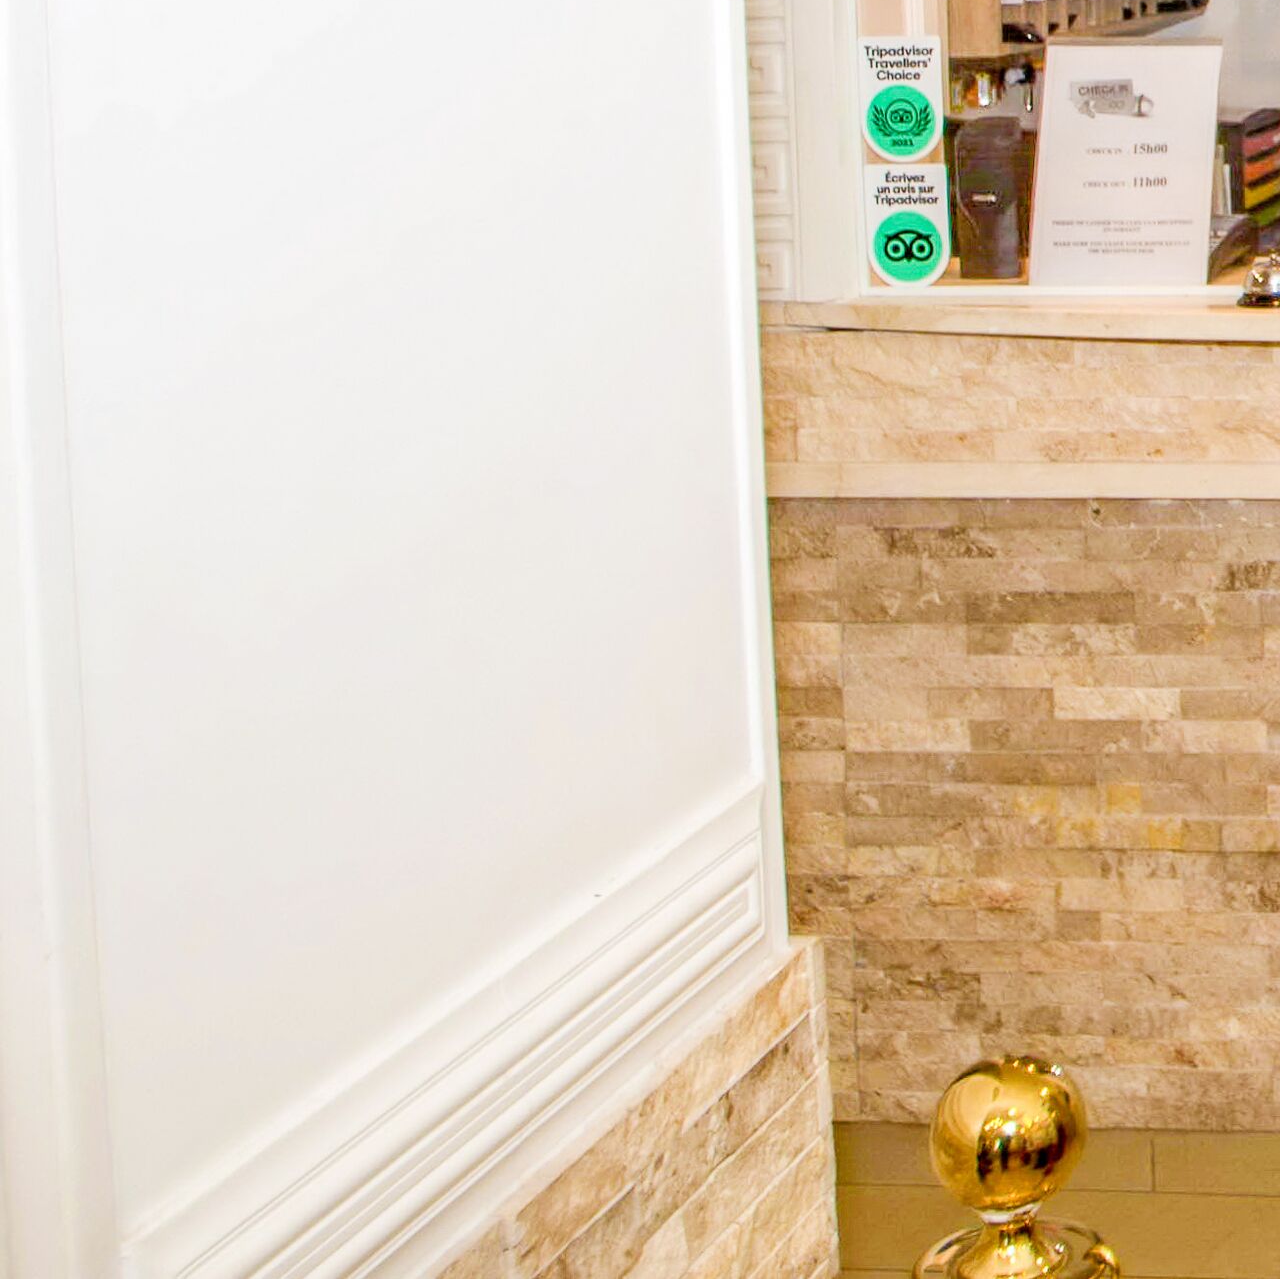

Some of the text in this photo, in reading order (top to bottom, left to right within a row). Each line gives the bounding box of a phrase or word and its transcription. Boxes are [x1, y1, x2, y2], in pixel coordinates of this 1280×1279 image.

[864, 45, 934, 59] Tripadvisor
[868, 58, 931, 69] Travellers'
[876, 70, 921, 81] Choice
[1133, 142, 1168, 155] 15h00
[885, 170, 926, 184] Écrivez
[1133, 176, 1168, 188] 11h00
[877, 184, 935, 194] un avis sur
[874, 195, 939, 207] Tripadvisor
